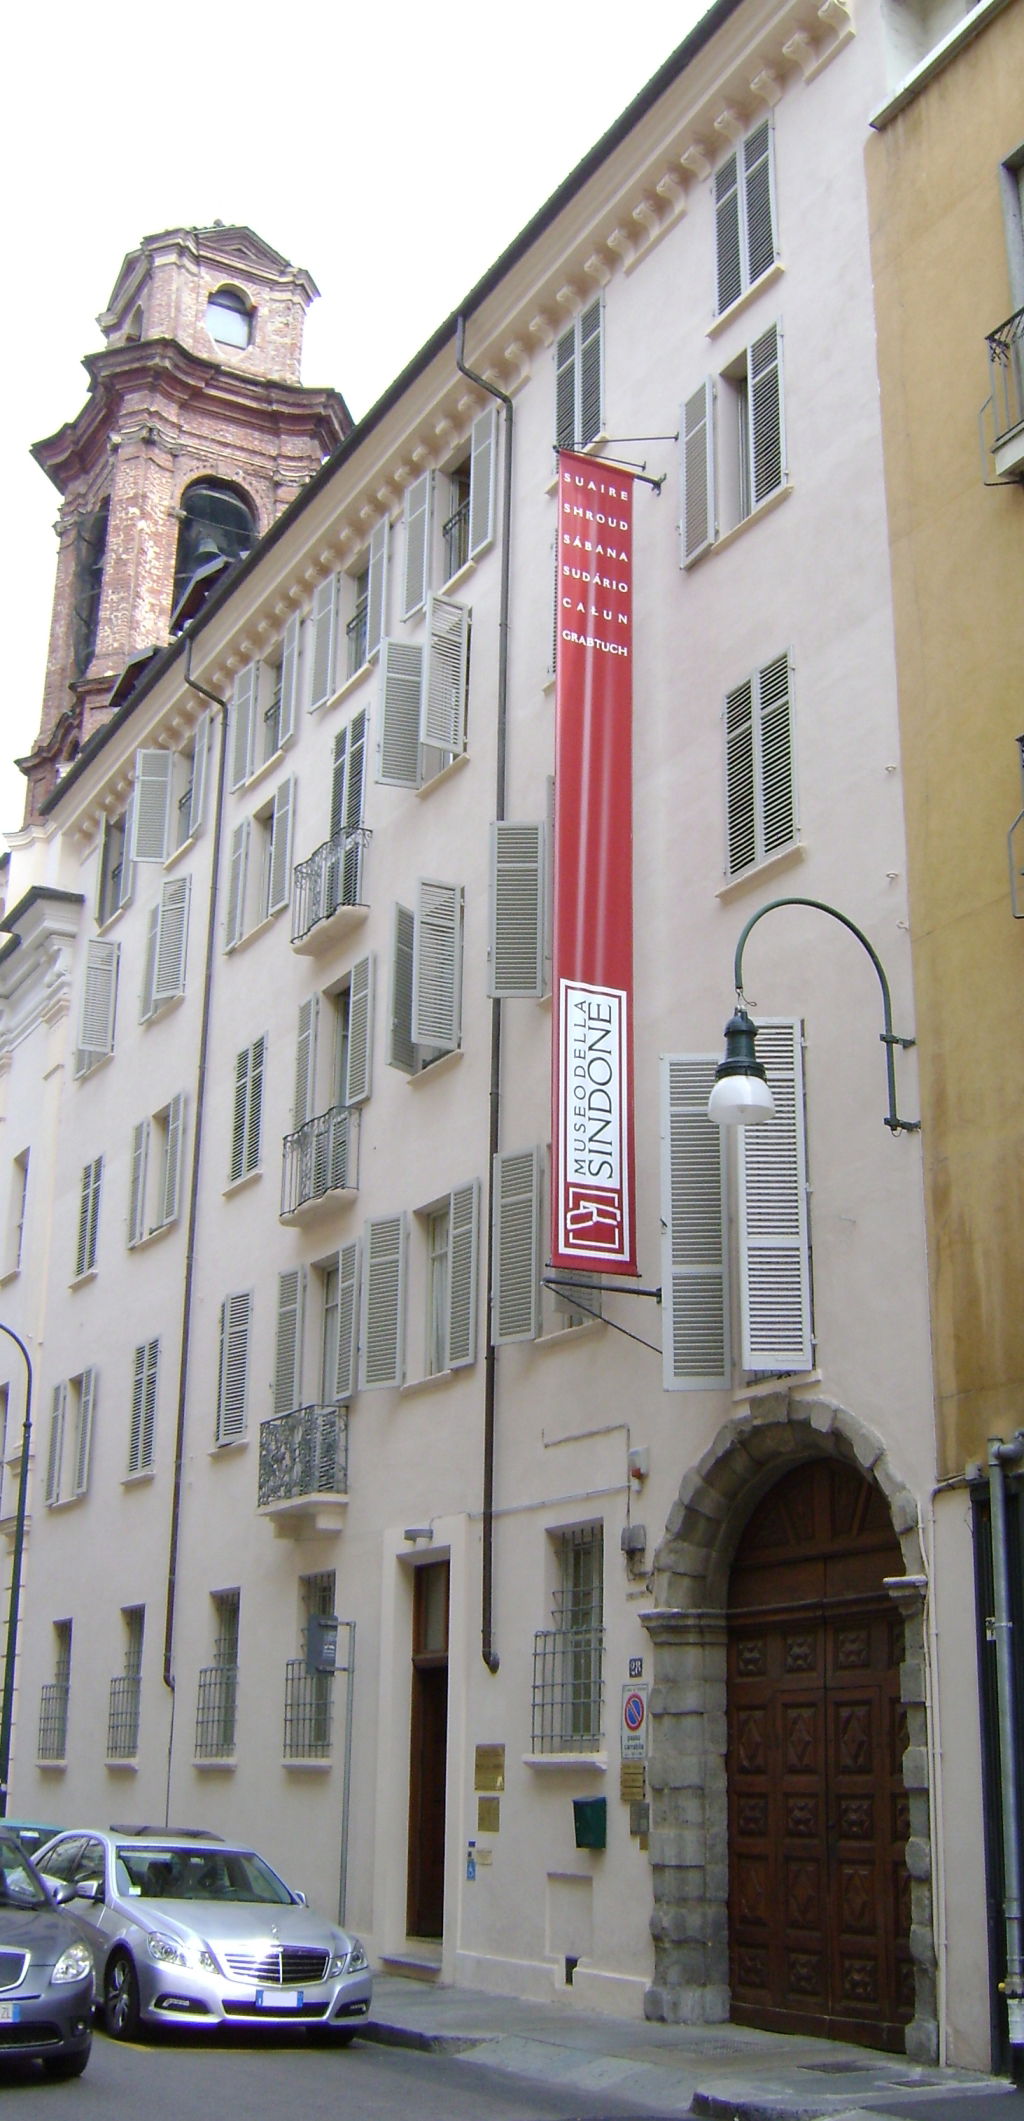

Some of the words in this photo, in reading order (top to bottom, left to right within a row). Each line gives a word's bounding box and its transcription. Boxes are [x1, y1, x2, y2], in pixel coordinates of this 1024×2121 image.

[563, 472, 628, 501] SUAIRE
[563, 503, 628, 531] SHROUD
[563, 534, 628, 562] SÁBANA
[563, 565, 628, 593] SUDÁRIO
[562, 597, 628, 625] CAŁUN
[562, 630, 628, 657] GRABTUCH
[587, 1002, 613, 1180] SINDONE
[630, 1661, 641, 1675] 28
